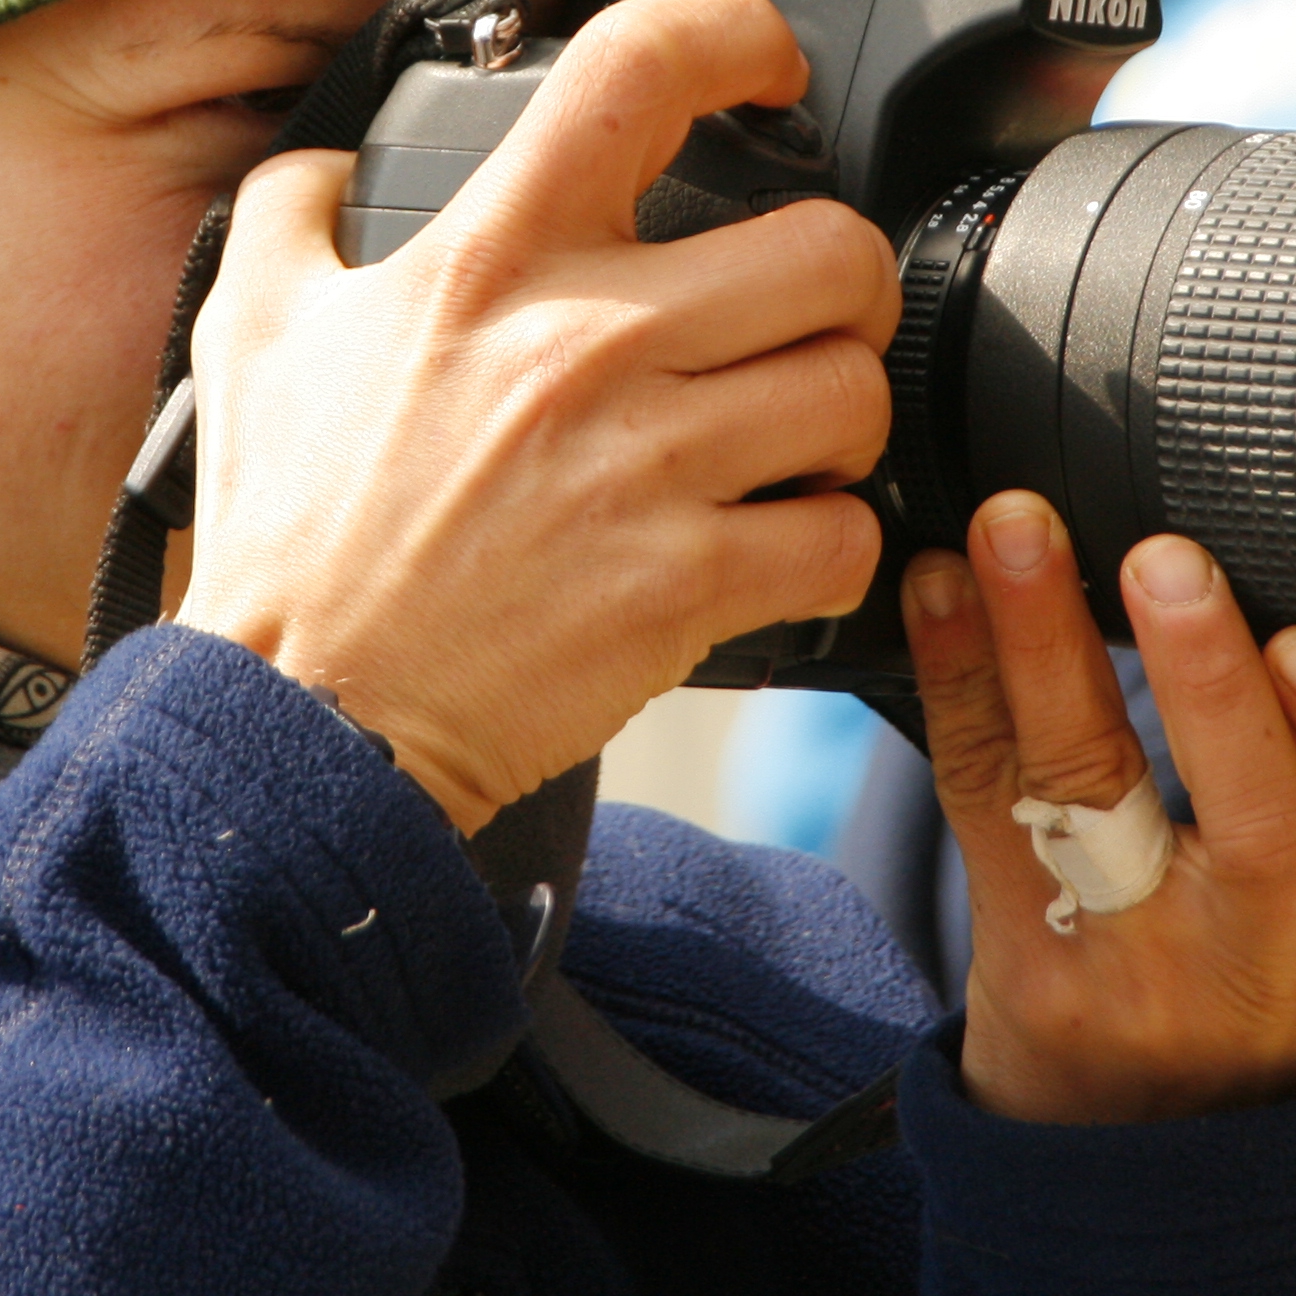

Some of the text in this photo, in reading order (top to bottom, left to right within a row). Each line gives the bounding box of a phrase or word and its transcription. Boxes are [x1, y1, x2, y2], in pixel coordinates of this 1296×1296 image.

[1184, 190, 1209, 210] 80
[926, 212, 944, 228] 2.8
[955, 212, 980, 233] 2.8
